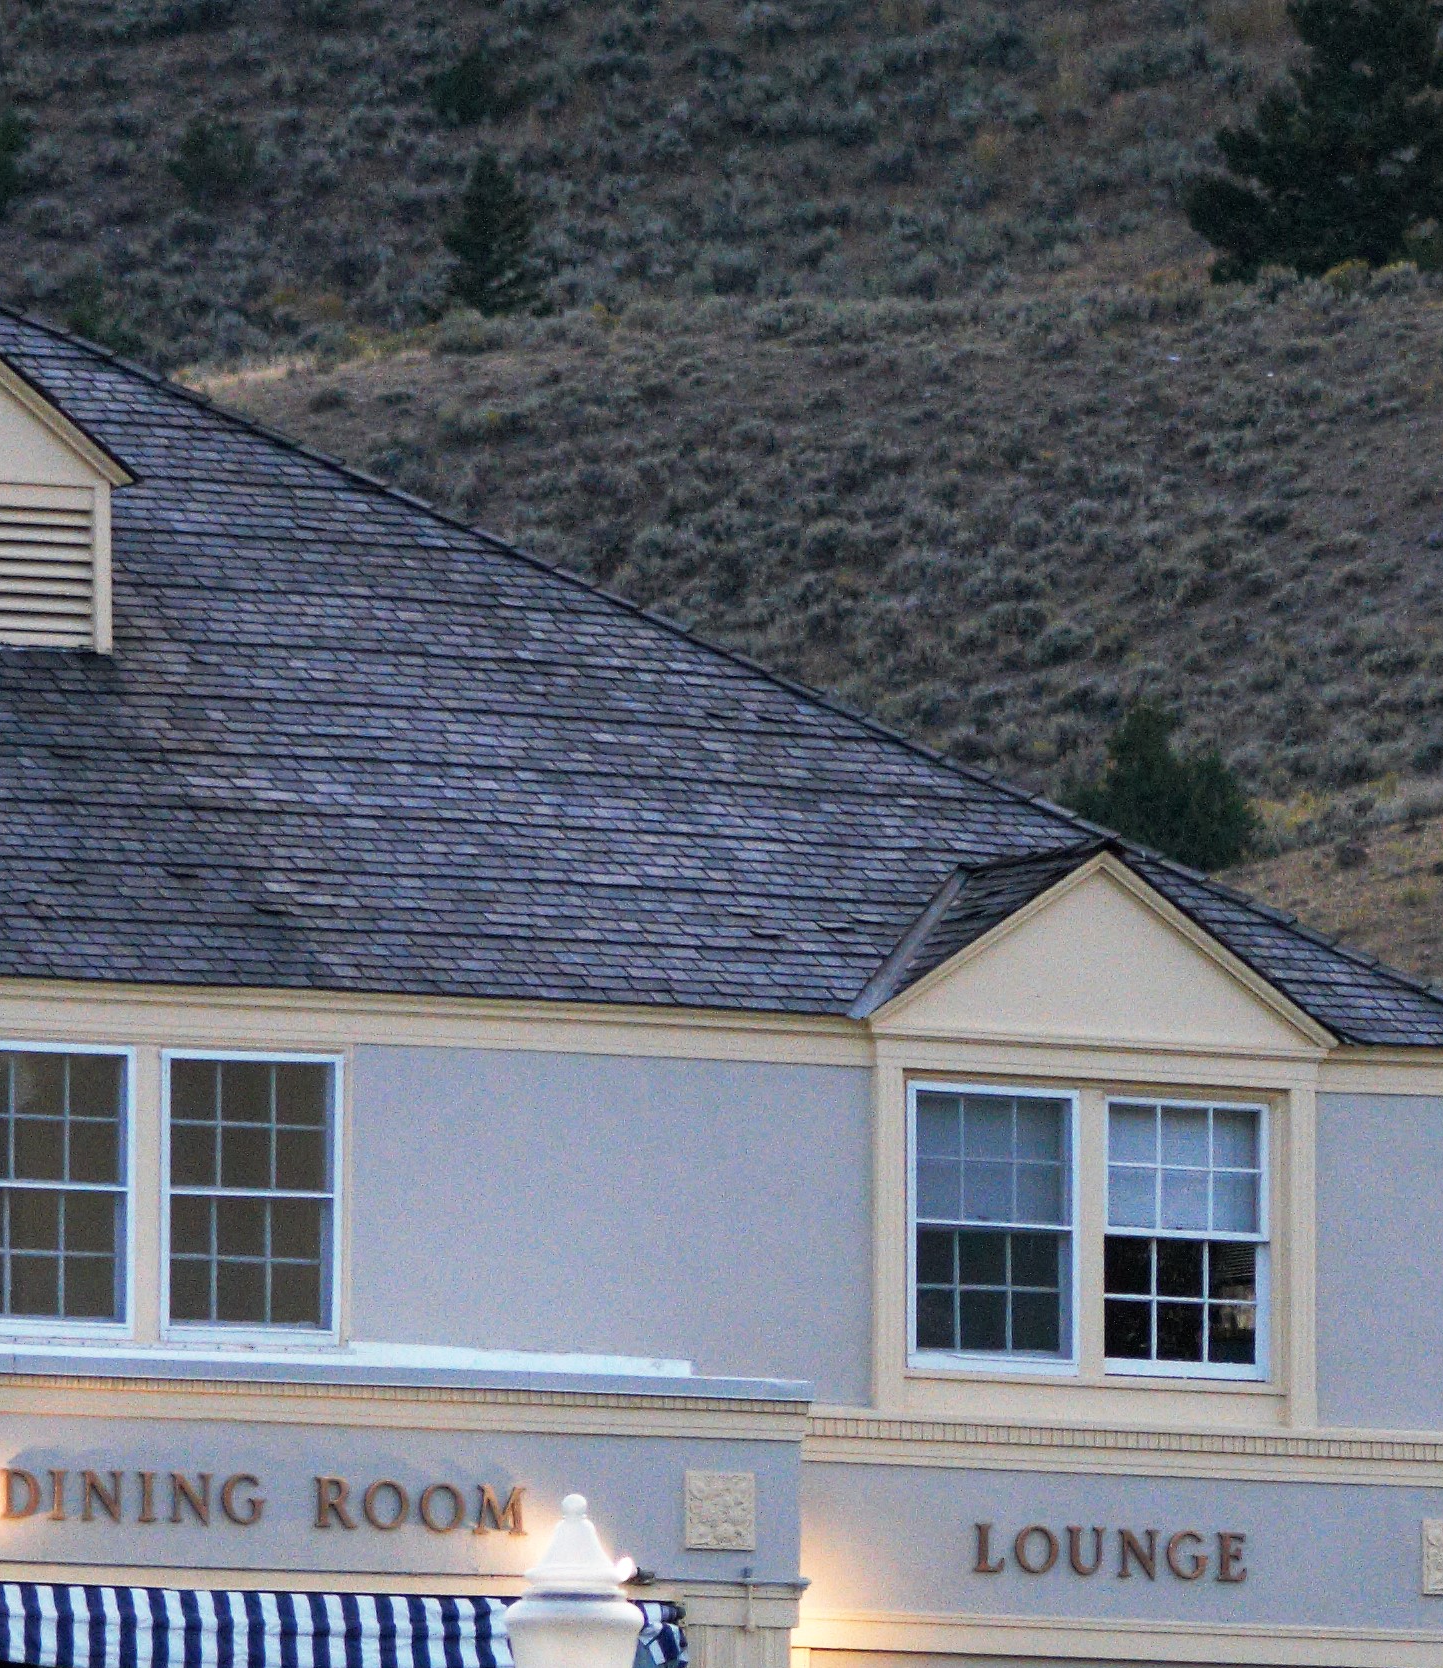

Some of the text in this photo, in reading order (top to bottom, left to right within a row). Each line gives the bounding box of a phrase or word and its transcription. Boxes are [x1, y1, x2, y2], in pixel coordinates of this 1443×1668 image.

[0, 1467, 527, 1536] DINING ROOM
[974, 1522, 1248, 1582] LOUNGE
